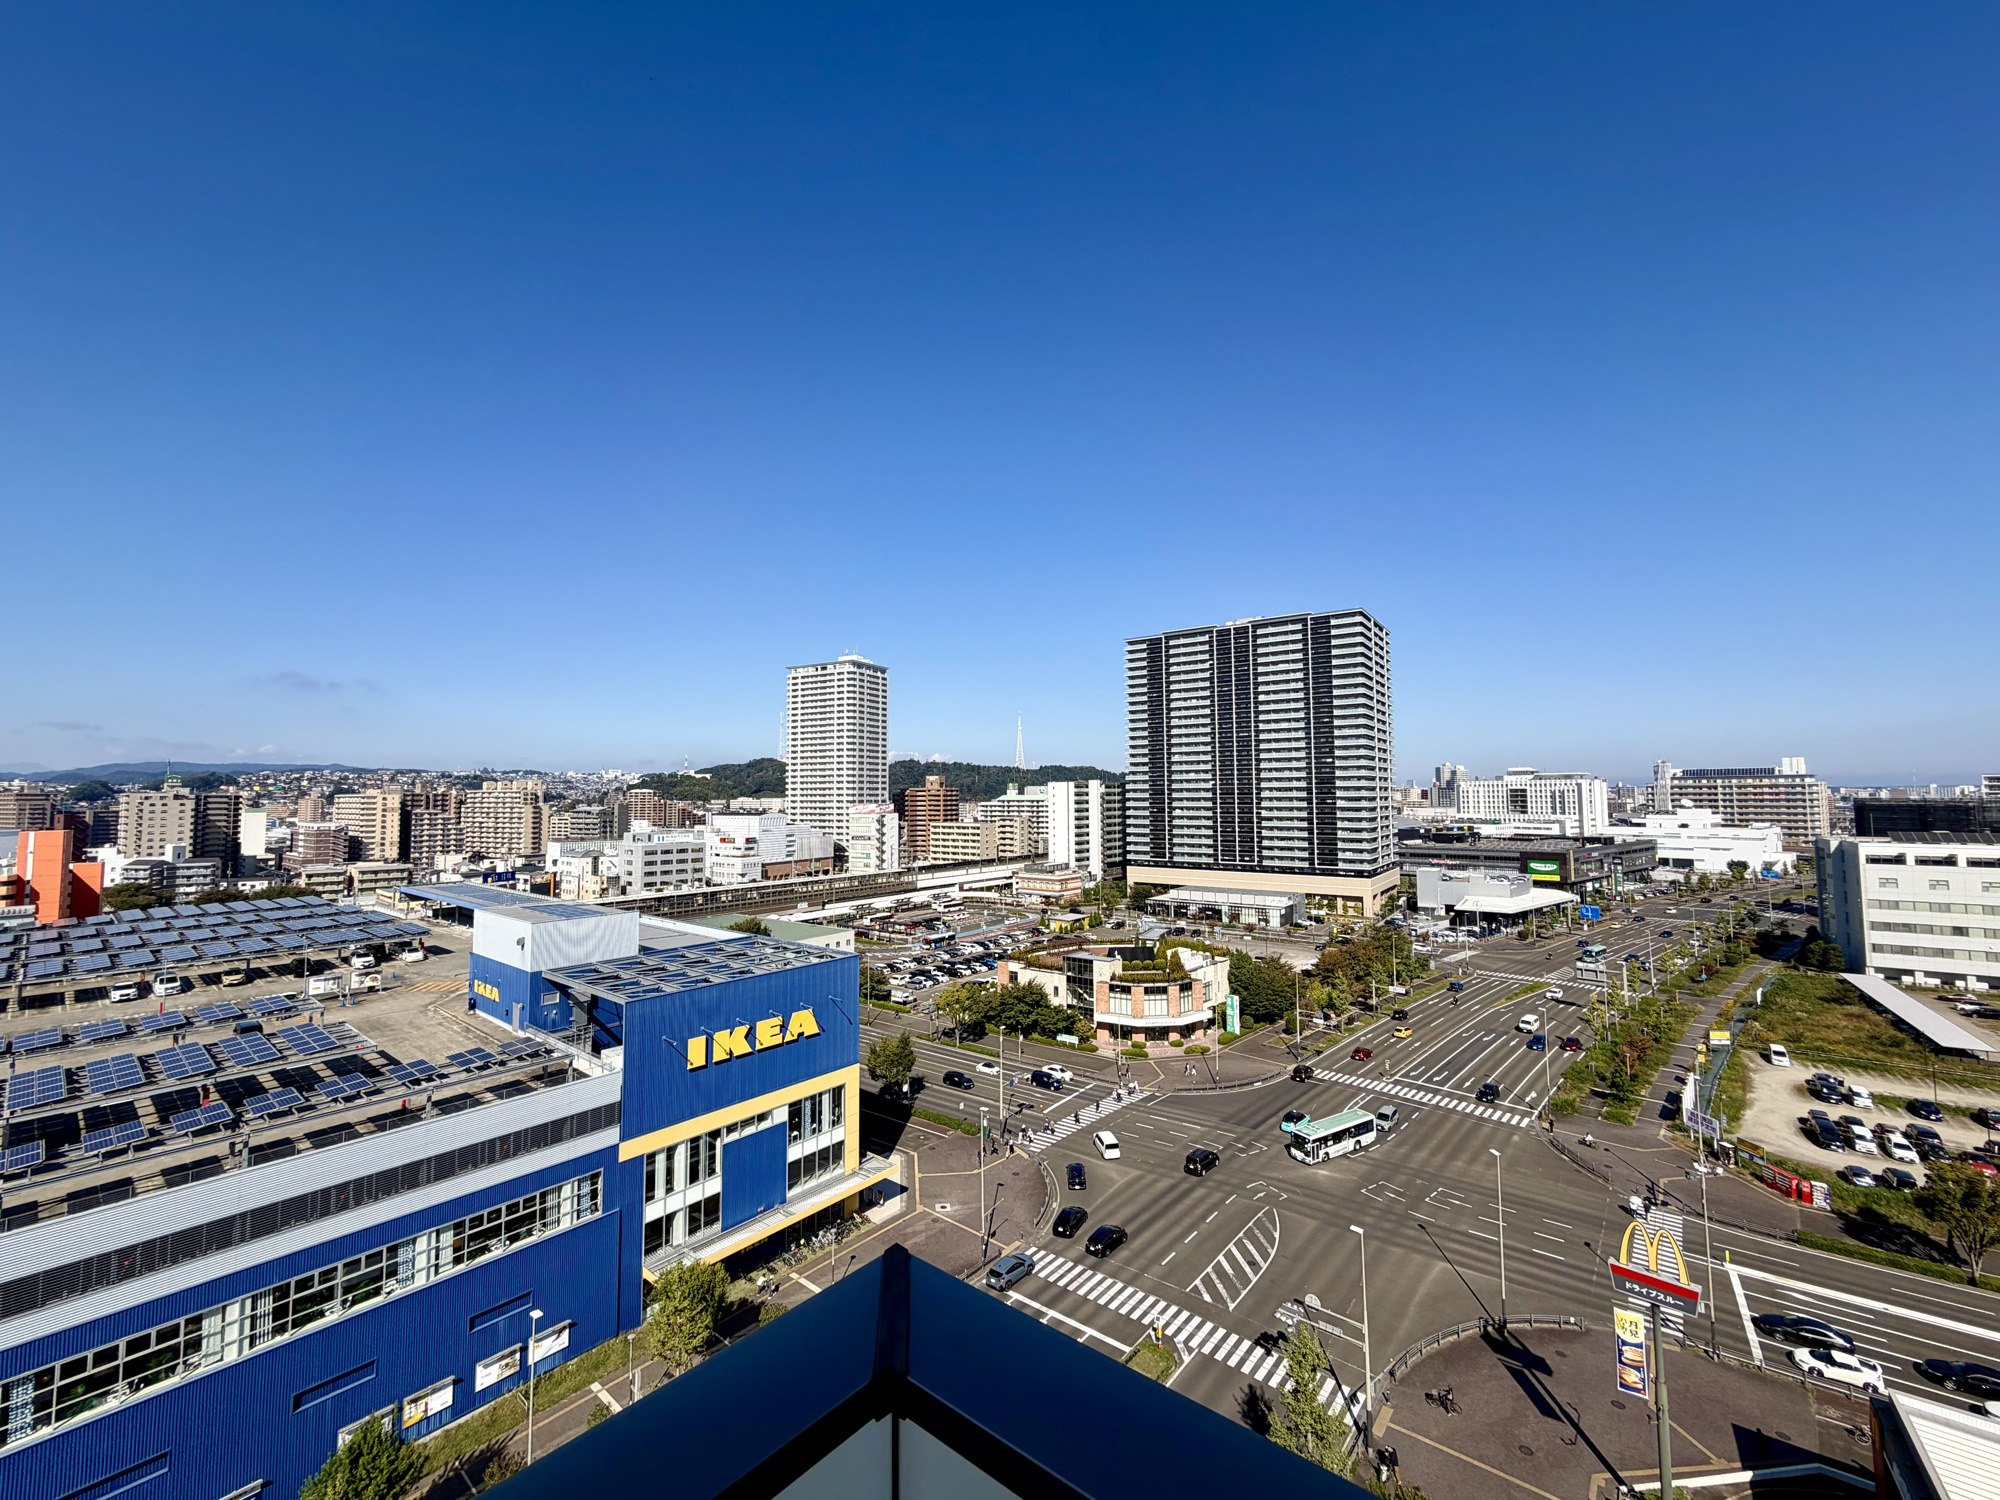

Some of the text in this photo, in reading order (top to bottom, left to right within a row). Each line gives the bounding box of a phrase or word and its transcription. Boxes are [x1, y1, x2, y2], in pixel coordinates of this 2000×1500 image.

[474, 979, 500, 1002] IKEA
[687, 1008, 820, 1070] IKEA
[1625, 1281, 1684, 1306] ドライブスルー
